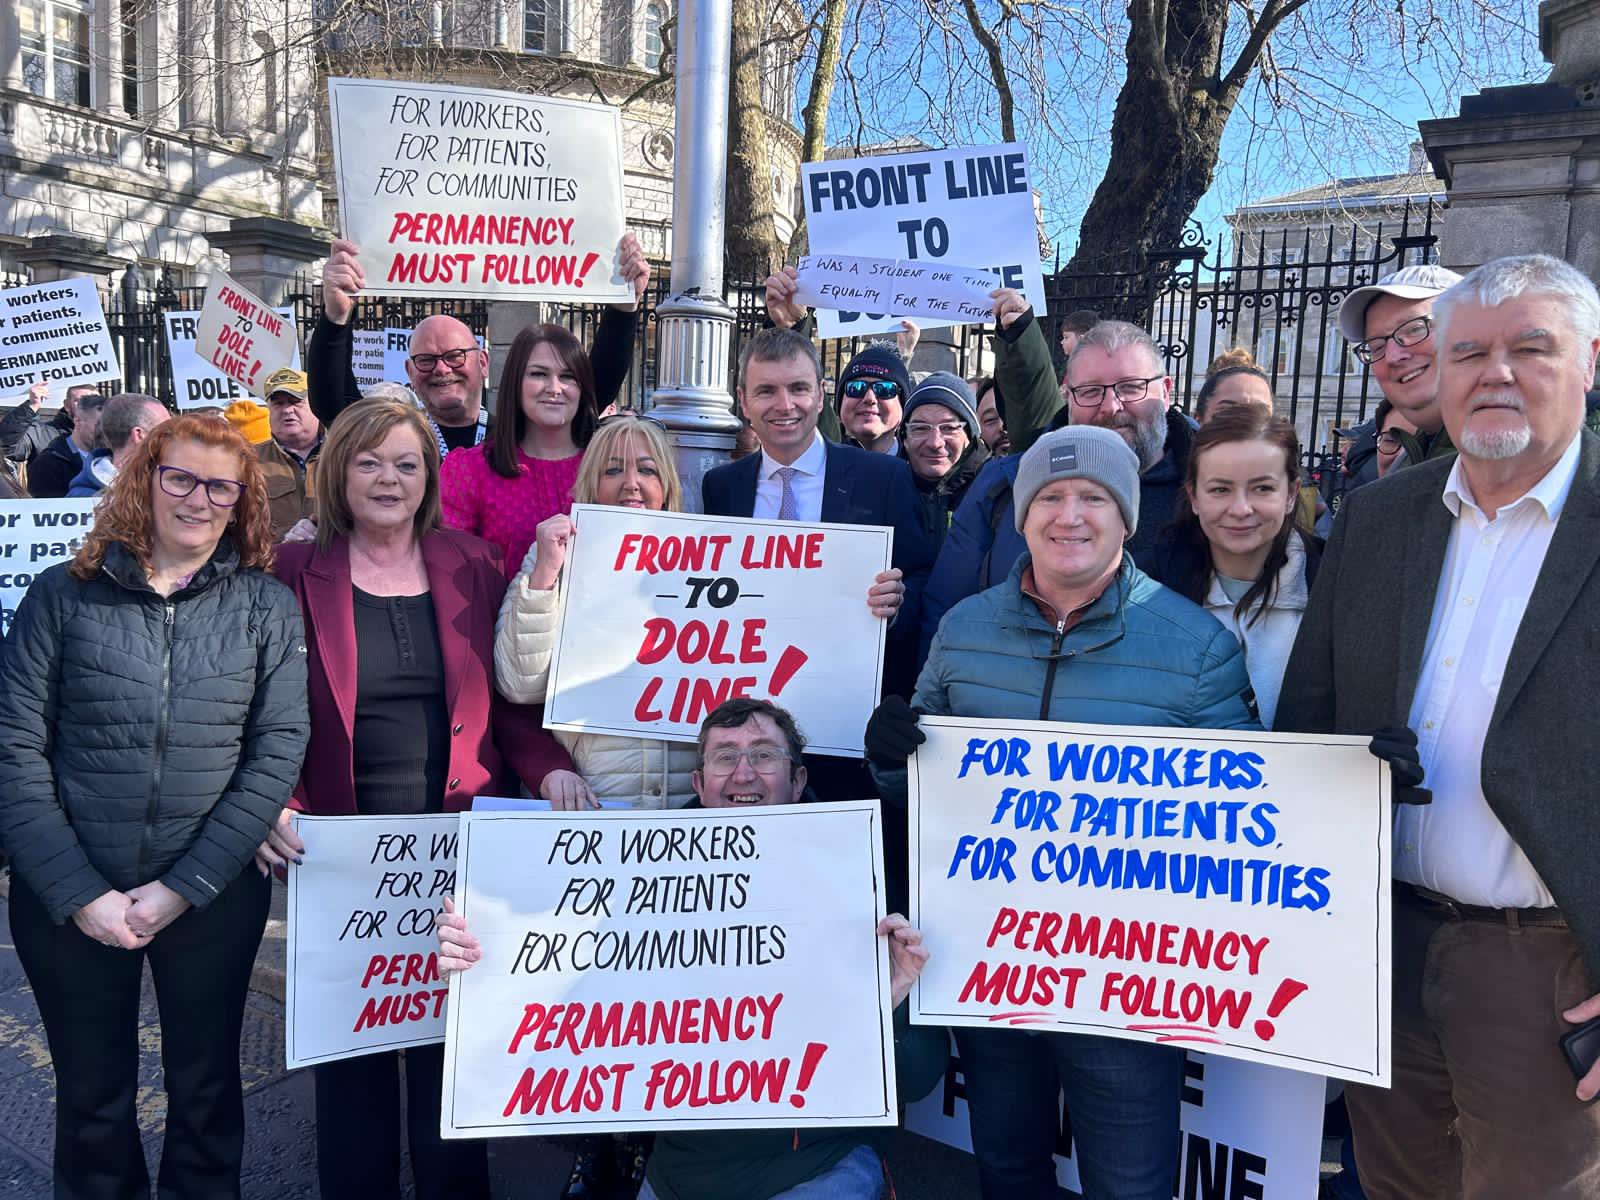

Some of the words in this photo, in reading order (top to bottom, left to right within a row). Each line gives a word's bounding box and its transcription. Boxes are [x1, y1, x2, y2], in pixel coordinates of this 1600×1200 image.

[390, 95, 431, 127] FOR
[440, 99, 551, 137] WORKERS,
[395, 133, 439, 162] FOR
[447, 136, 552, 170] PATIENTS,
[374, 167, 419, 197] FOR
[427, 171, 579, 202] COMMUNITIES
[809, 163, 931, 213] FRONT
[944, 153, 1028, 200] LINE
[897, 216, 950, 260] TO
[387, 253, 475, 284] MUST
[482, 252, 600, 288] FOLLOW!
[799, 259, 809, 271] I
[816, 258, 843, 272] WAS
[849, 263, 859, 275] A
[869, 263, 926, 278] STUDENT
[931, 272, 953, 282] ONE
[6, 288, 79, 307] workers,
[218, 286, 257, 317] FRONT
[256, 310, 283, 338] LINE
[820, 284, 880, 301] EQUALITY
[893, 293, 918, 308] FOR
[927, 298, 951, 311] THE
[1, 321, 102, 346] communities
[12, 306, 82, 328] patients,
[170, 317, 200, 340] FR
[234, 315, 253, 333] TO
[217, 324, 254, 360] DOLE
[387, 333, 411, 352] FR
[41, 360, 108, 381] FOLLOW
[212, 347, 262, 386] LINE!
[186, 378, 241, 400] DOLE
[613, 534, 732, 575] FRONT
[740, 533, 824, 569] LINE
[684, 577, 740, 608] TO
[636, 618, 767, 664] DOLE
[957, 737, 1031, 779] FOR
[1048, 742, 1269, 790] WORKERS,
[991, 787, 1061, 832] FOR
[1070, 793, 1283, 849] PATIENTS,
[371, 834, 417, 864] FOR
[548, 829, 603, 865] FOR
[621, 825, 760, 865] WORKERS,
[947, 834, 1017, 883] FOR
[375, 871, 423, 899] FOR
[555, 877, 615, 917] FOR
[625, 873, 750, 914] PATIENTS
[339, 910, 387, 941] FOR
[986, 907, 1270, 976] PERMANENCY
[511, 932, 563, 975] FOR
[571, 924, 786, 972] COMMUNITIES
[353, 988, 449, 1033] MUST
[958, 961, 1086, 1008] MUST
[1100, 972, 1308, 1041] FOLLOW!
[507, 992, 784, 1055] PERMANENCY
[502, 1063, 635, 1118] MUST
[643, 1042, 828, 1112] FOLLOW!
